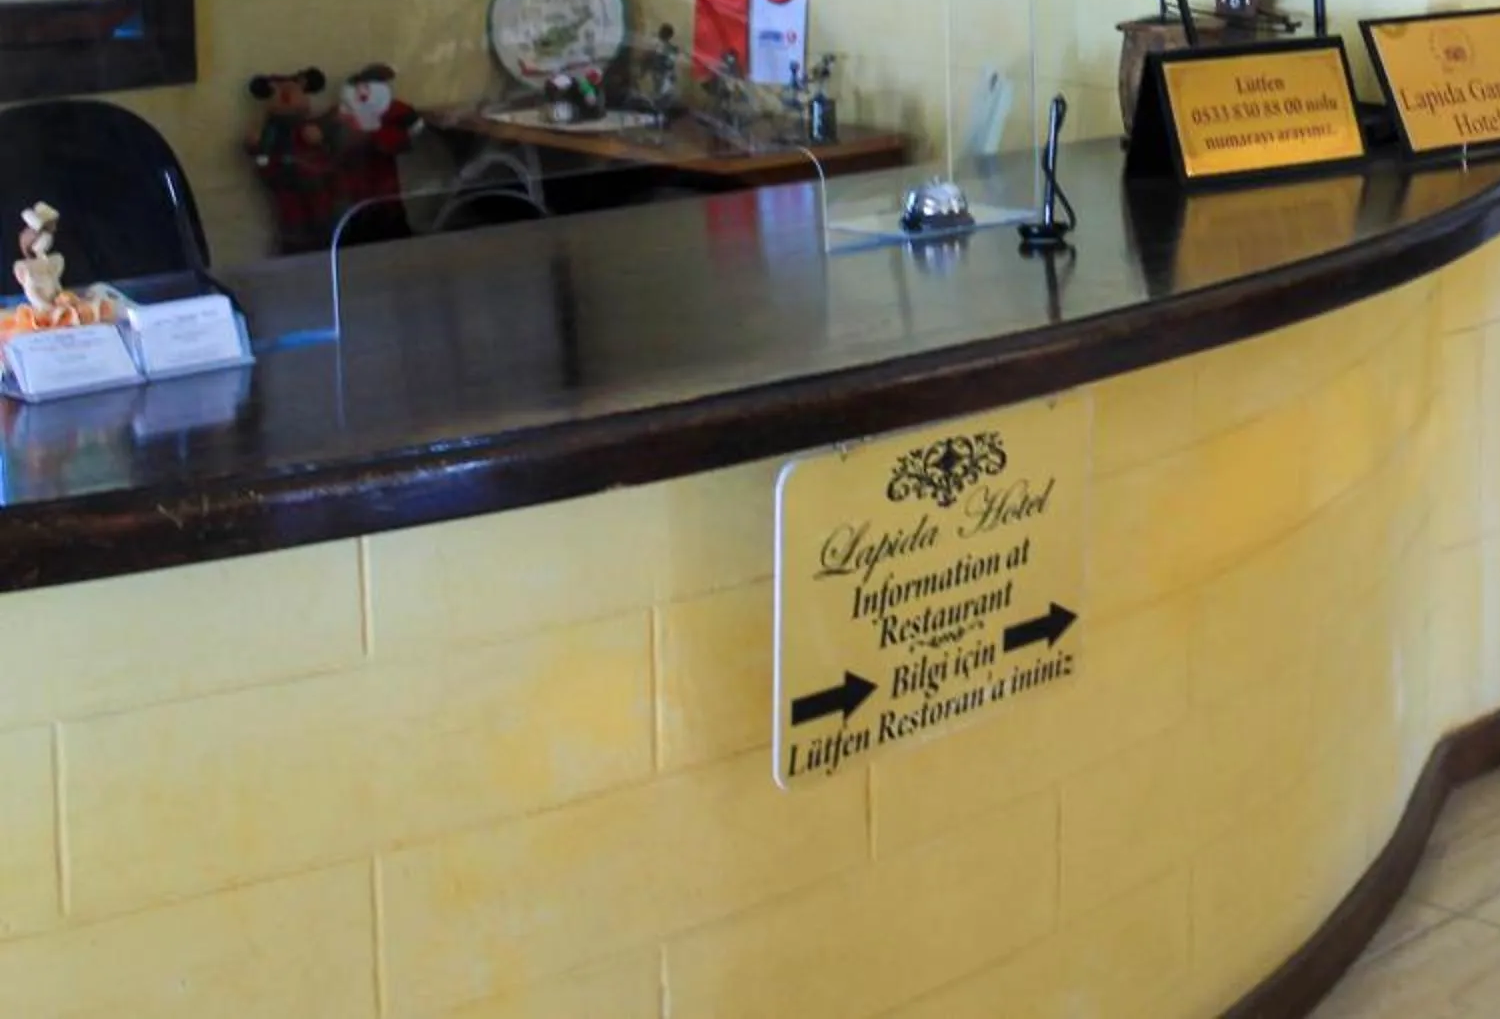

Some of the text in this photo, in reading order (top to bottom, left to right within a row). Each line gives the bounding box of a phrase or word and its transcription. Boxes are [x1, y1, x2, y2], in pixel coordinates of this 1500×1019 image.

[1400, 80, 1467, 117] Lapida
[813, 478, 1056, 584] Lapida Hotel
[851, 536, 1031, 624] Information at
[879, 579, 1013, 649] Restaurant
[891, 639, 997, 699] Bilgi için
[788, 726, 870, 778] Lütfen
[1010, 649, 1074, 696] ininiz
